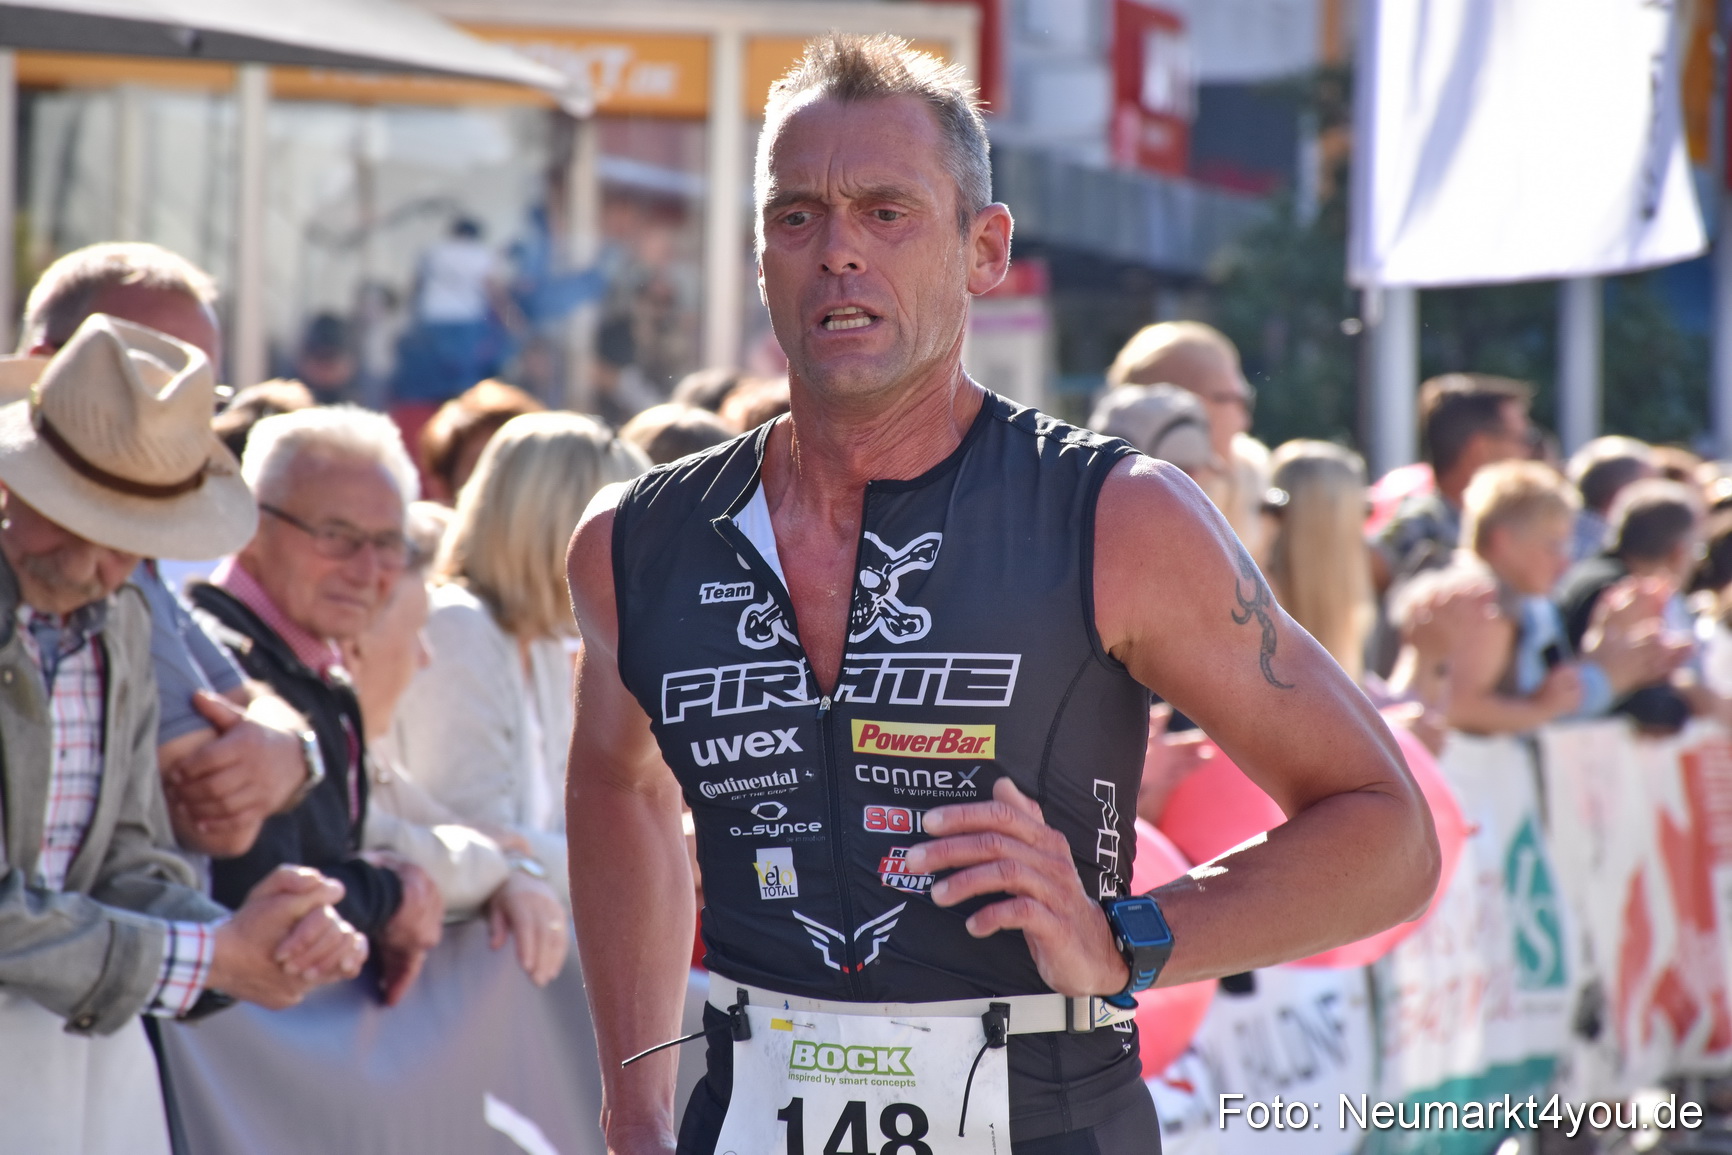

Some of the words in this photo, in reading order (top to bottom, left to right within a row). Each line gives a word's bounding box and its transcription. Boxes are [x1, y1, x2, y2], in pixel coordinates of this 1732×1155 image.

[702, 584, 753, 602] Team
[691, 727, 803, 767] uvex
[699, 768, 798, 799] Continental
[893, 787, 905, 795] BY
[907, 788, 977, 797] WIPPERMANN
[752, 861, 793, 887] Velo
[888, 874, 933, 890] TOP
[762, 885, 796, 898] TOTAL
[789, 1040, 915, 1076] BOCK
[788, 1071, 822, 1083] inspired
[824, 1075, 836, 1086] by
[838, 1077, 868, 1086] smart
[870, 1079, 916, 1089] concepts
[777, 1097, 933, 1155] 148
